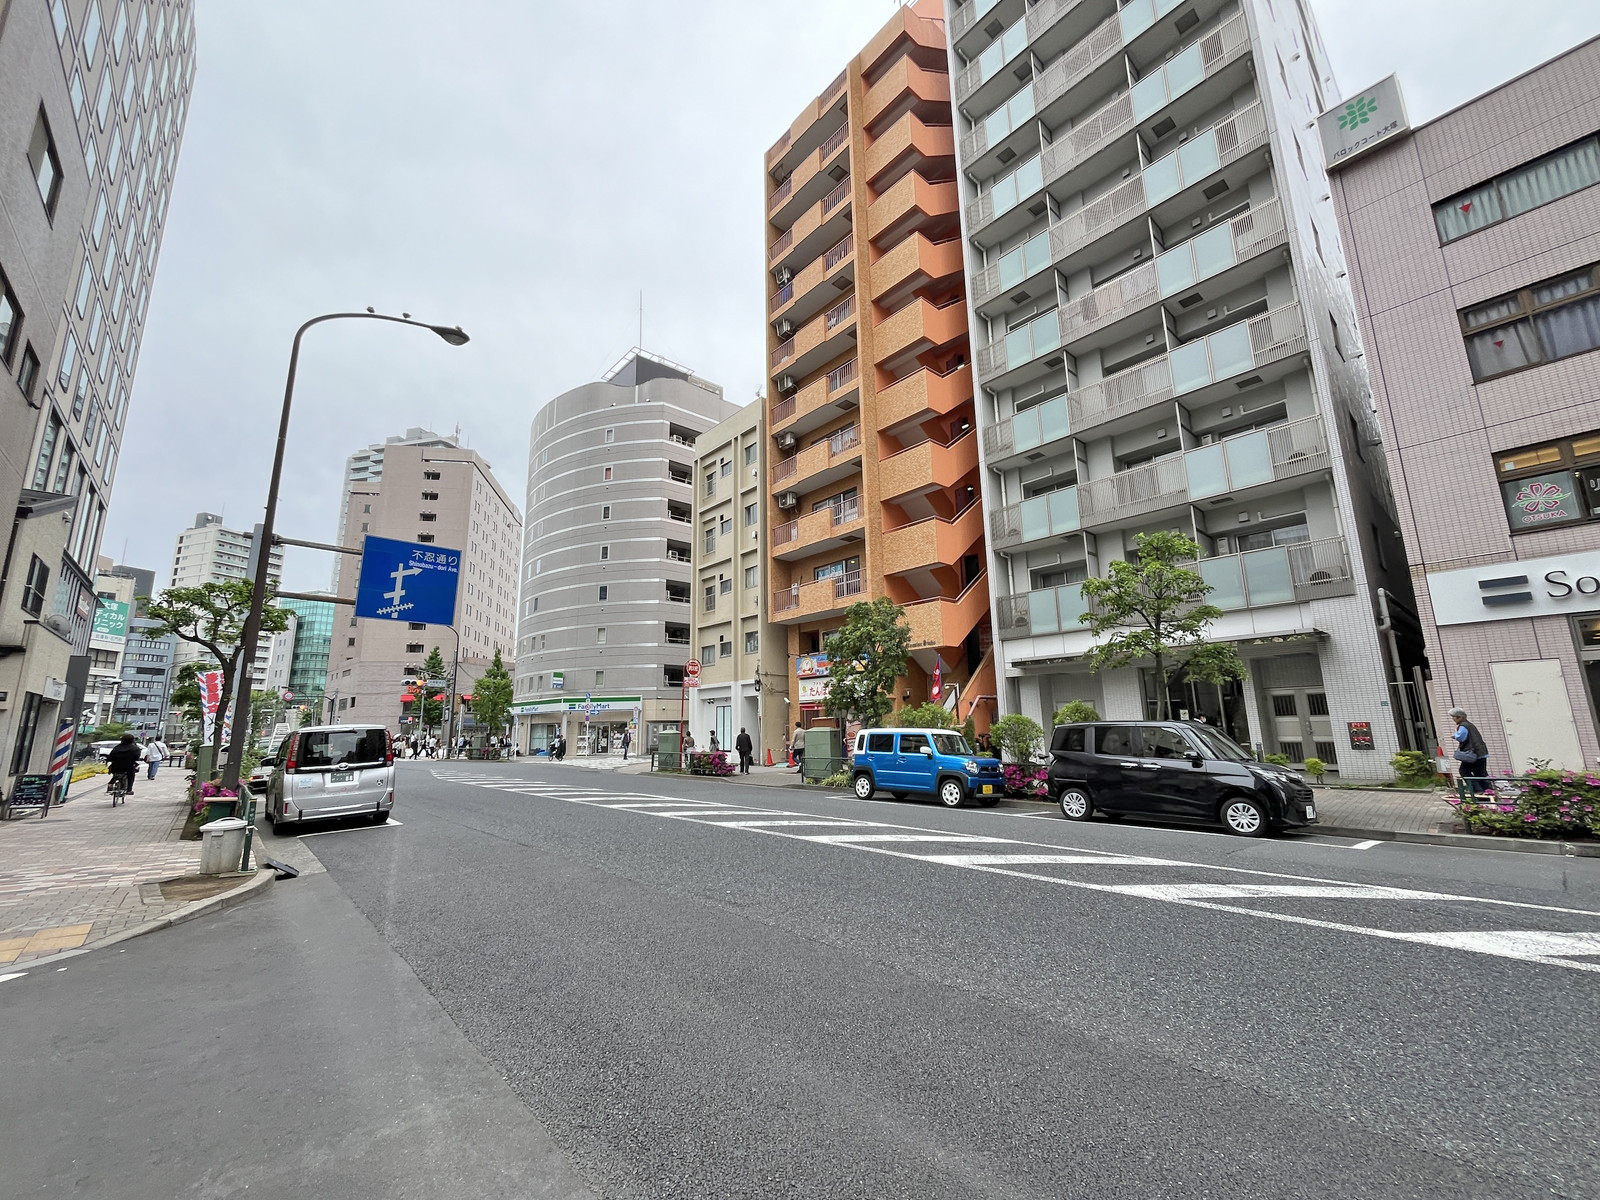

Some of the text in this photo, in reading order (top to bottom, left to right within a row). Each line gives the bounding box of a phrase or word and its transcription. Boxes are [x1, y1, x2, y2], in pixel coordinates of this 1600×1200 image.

[1333, 120, 1398, 160] バロックコート大塚
[1522, 509, 1568, 523] OTSUKA
[412, 550, 458, 566] 不忍通り
[1544, 570, 1600, 598] So
[577, 703, 610, 711] FailyMart
